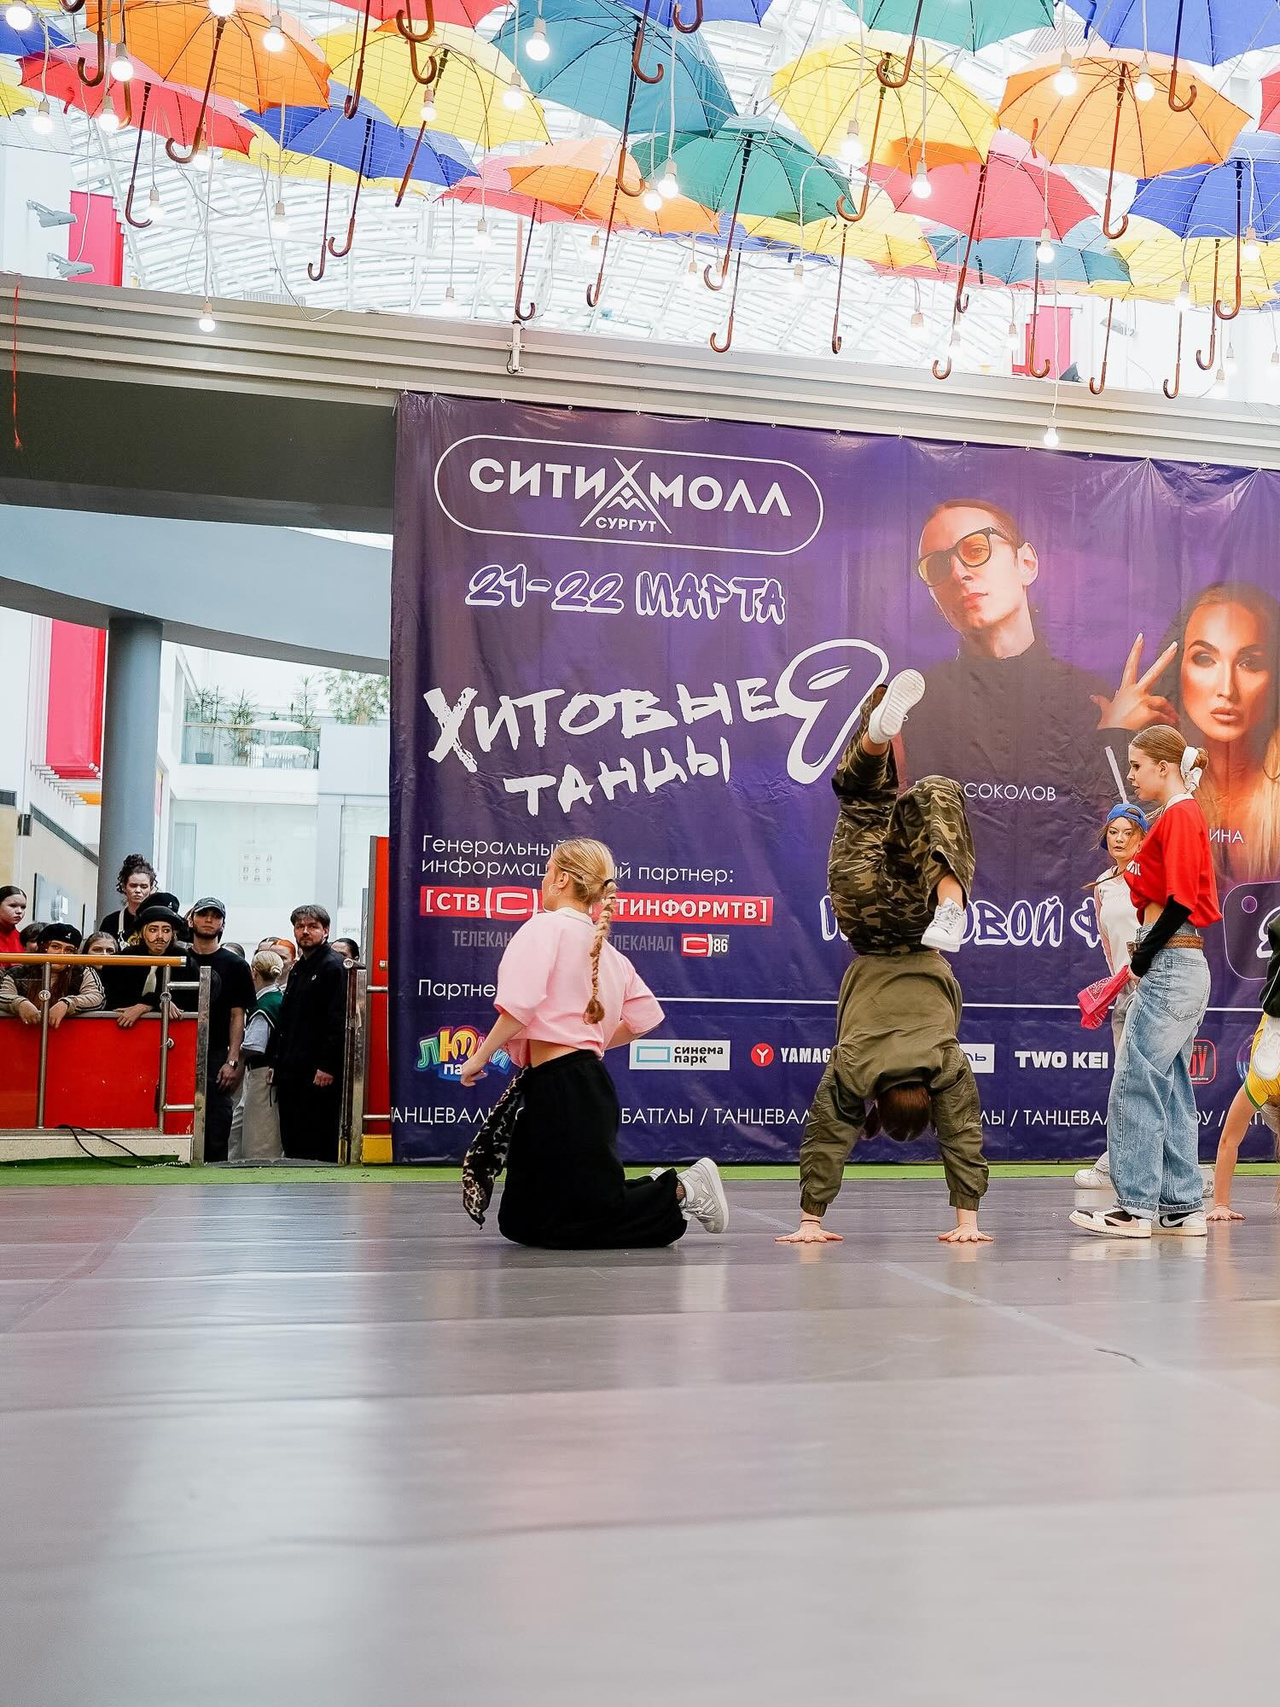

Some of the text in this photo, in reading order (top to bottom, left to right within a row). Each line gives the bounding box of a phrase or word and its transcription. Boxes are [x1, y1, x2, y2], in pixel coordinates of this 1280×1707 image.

[595, 515, 657, 535] СУРГУТ
[465, 564, 786, 626] 21-22 МАРТА
[423, 676, 778, 774] ХИТОВЫЕ
[503, 735, 731, 817] ТАНЦЫ
[963, 782, 1057, 801] СОКОЛОВ
[639, 865, 734, 886] партнер:
[452, 930, 513, 948] ТЕЛЕКАН
[418, 979, 497, 1000] Партне
[673, 1045, 724, 1055] синема
[673, 1053, 707, 1065] парк
[780, 1047, 831, 1063] YAMAG
[1014, 1050, 1068, 1069] TWO
[621, 1107, 693, 1125] БАТТЛЫ
